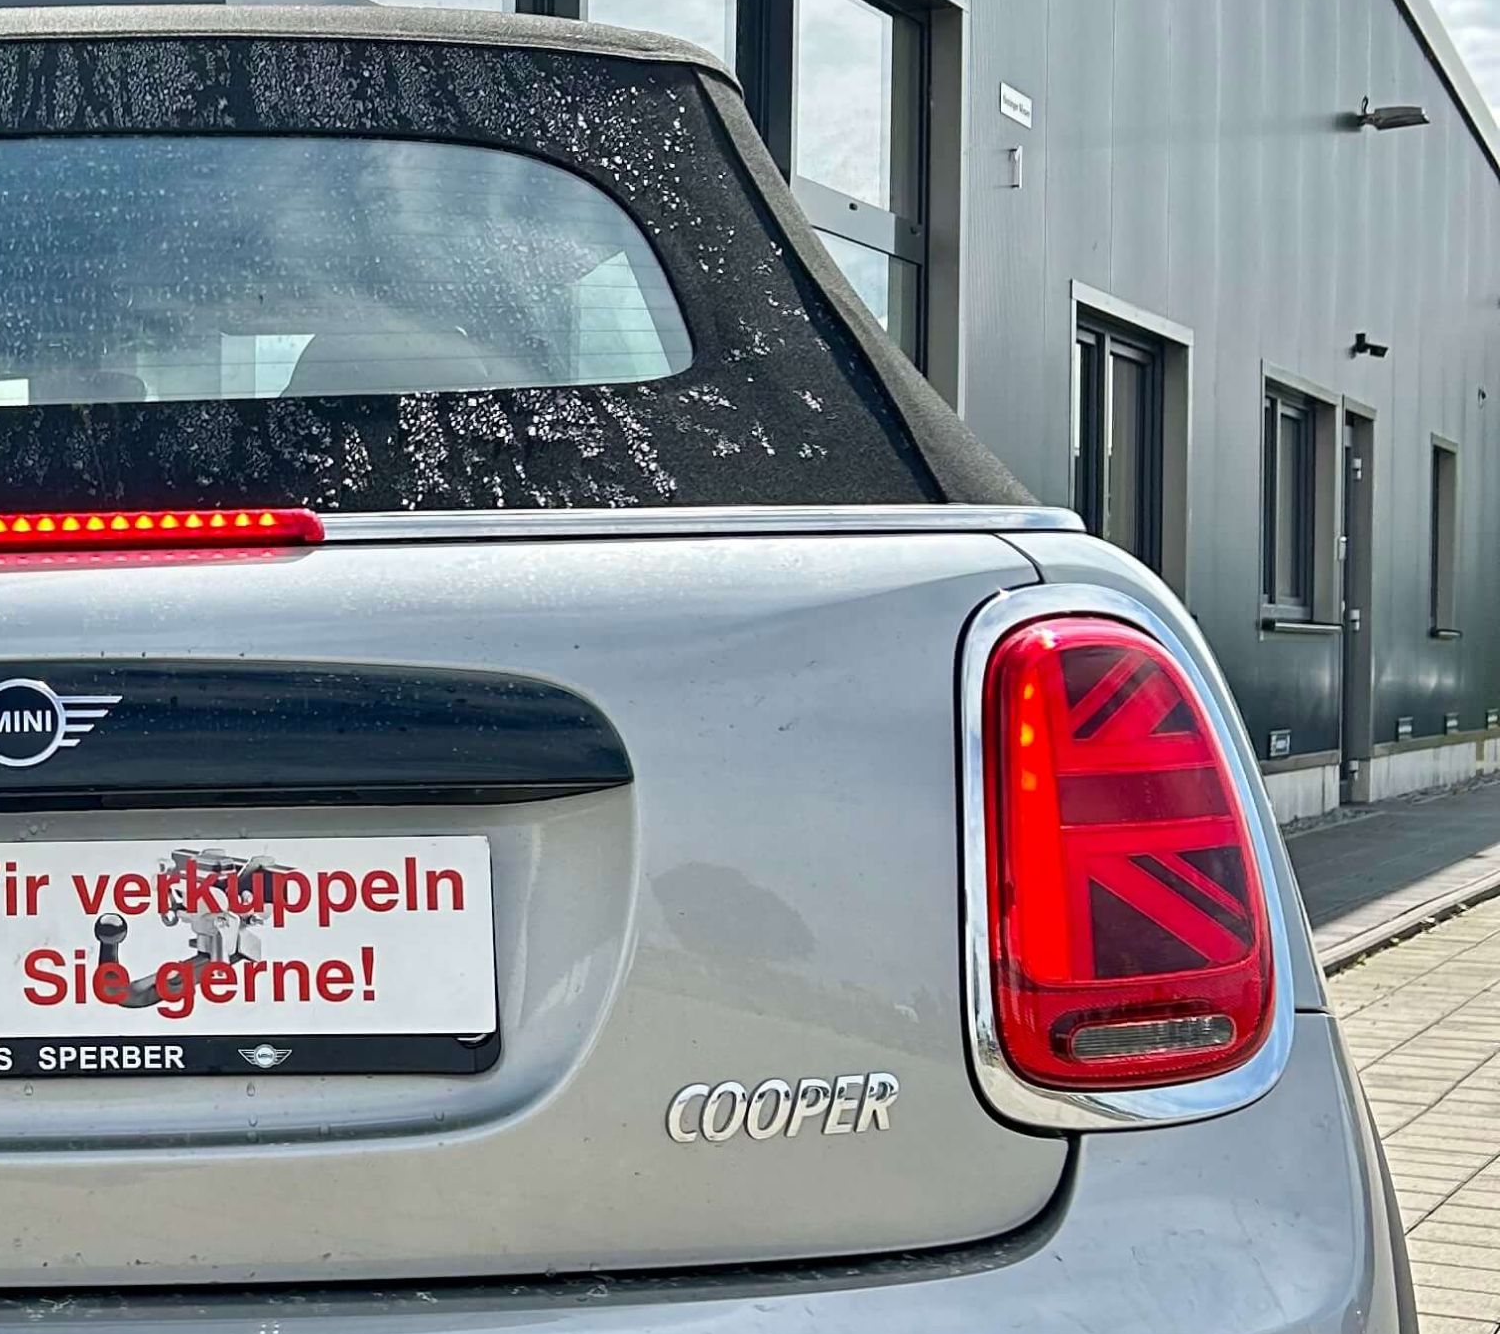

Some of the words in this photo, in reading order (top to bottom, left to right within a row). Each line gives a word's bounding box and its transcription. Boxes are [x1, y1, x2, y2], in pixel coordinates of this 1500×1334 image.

[71, 856, 465, 928] verkuppeln
[22, 947, 131, 1005] Sie
[155, 946, 377, 1019] gerne!
[37, 1045, 186, 1072] SPERBER
[665, 1071, 900, 1143] COOPER
